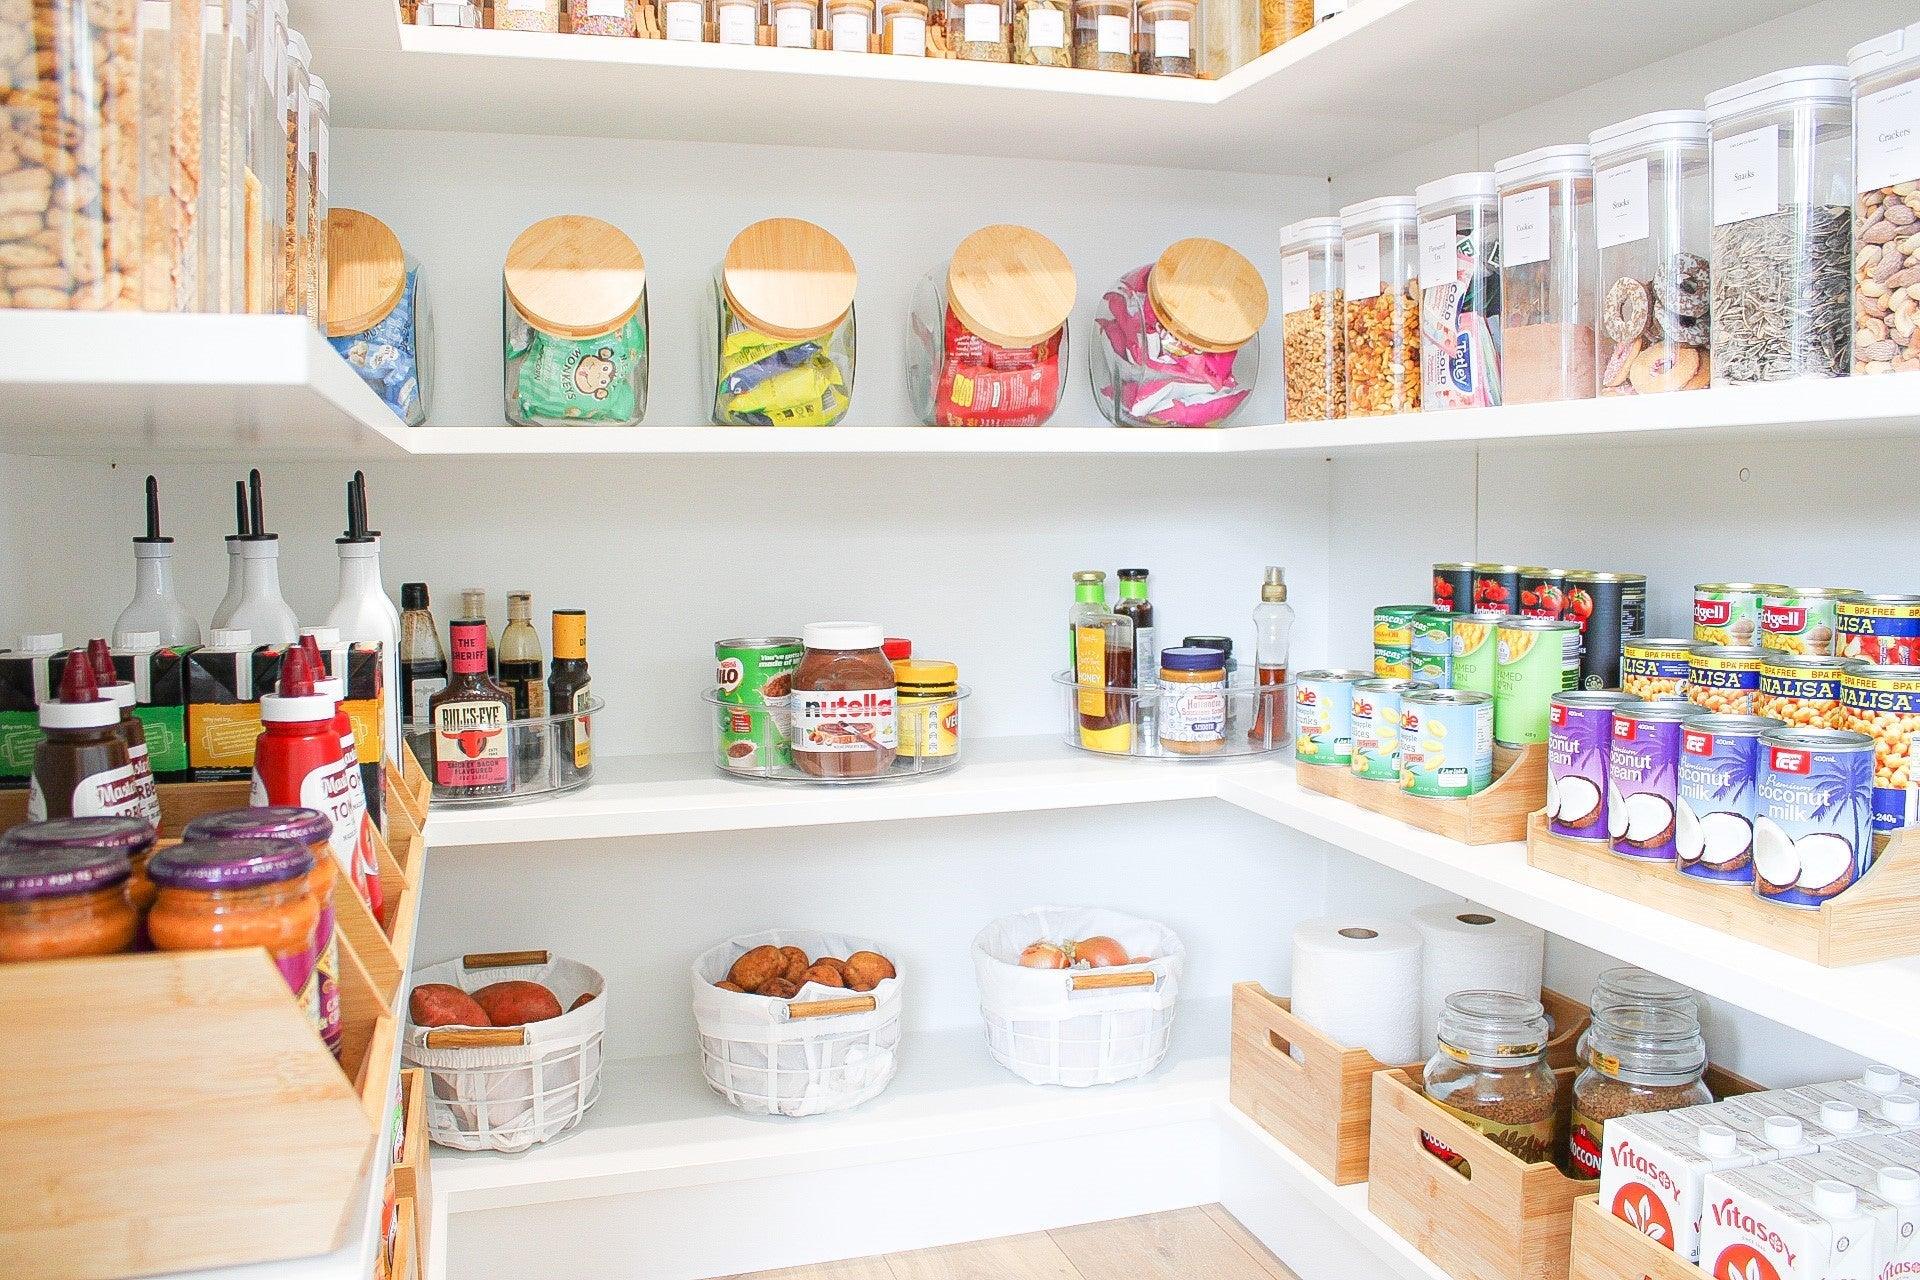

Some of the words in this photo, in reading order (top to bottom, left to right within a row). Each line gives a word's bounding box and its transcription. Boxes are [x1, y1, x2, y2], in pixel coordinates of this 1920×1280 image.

[1444, 284, 1458, 320] COLD
[1453, 340, 1468, 387] Tetley
[562, 347, 581, 400] MONKEYS
[1855, 606, 1870, 615] BPA
[1872, 608, 1896, 616] FREE
[457, 638, 476, 648] THE
[1644, 651, 1659, 659] BPA
[1661, 652, 1681, 660] FREE
[1720, 661, 1737, 669] BPA
[1738, 662, 1761, 670] FREE
[1777, 668, 1797, 678] FREE
[1811, 671, 1829, 679] BPA
[1856, 679, 1877, 688] FREE
[1892, 682, 1912, 690] BPA
[806, 693, 892, 718] nutella
[1681, 782, 1711, 802] milk
[1766, 773, 1815, 792] Premium
[1758, 783, 1832, 807] coconut
[1768, 803, 1809, 822] milk
